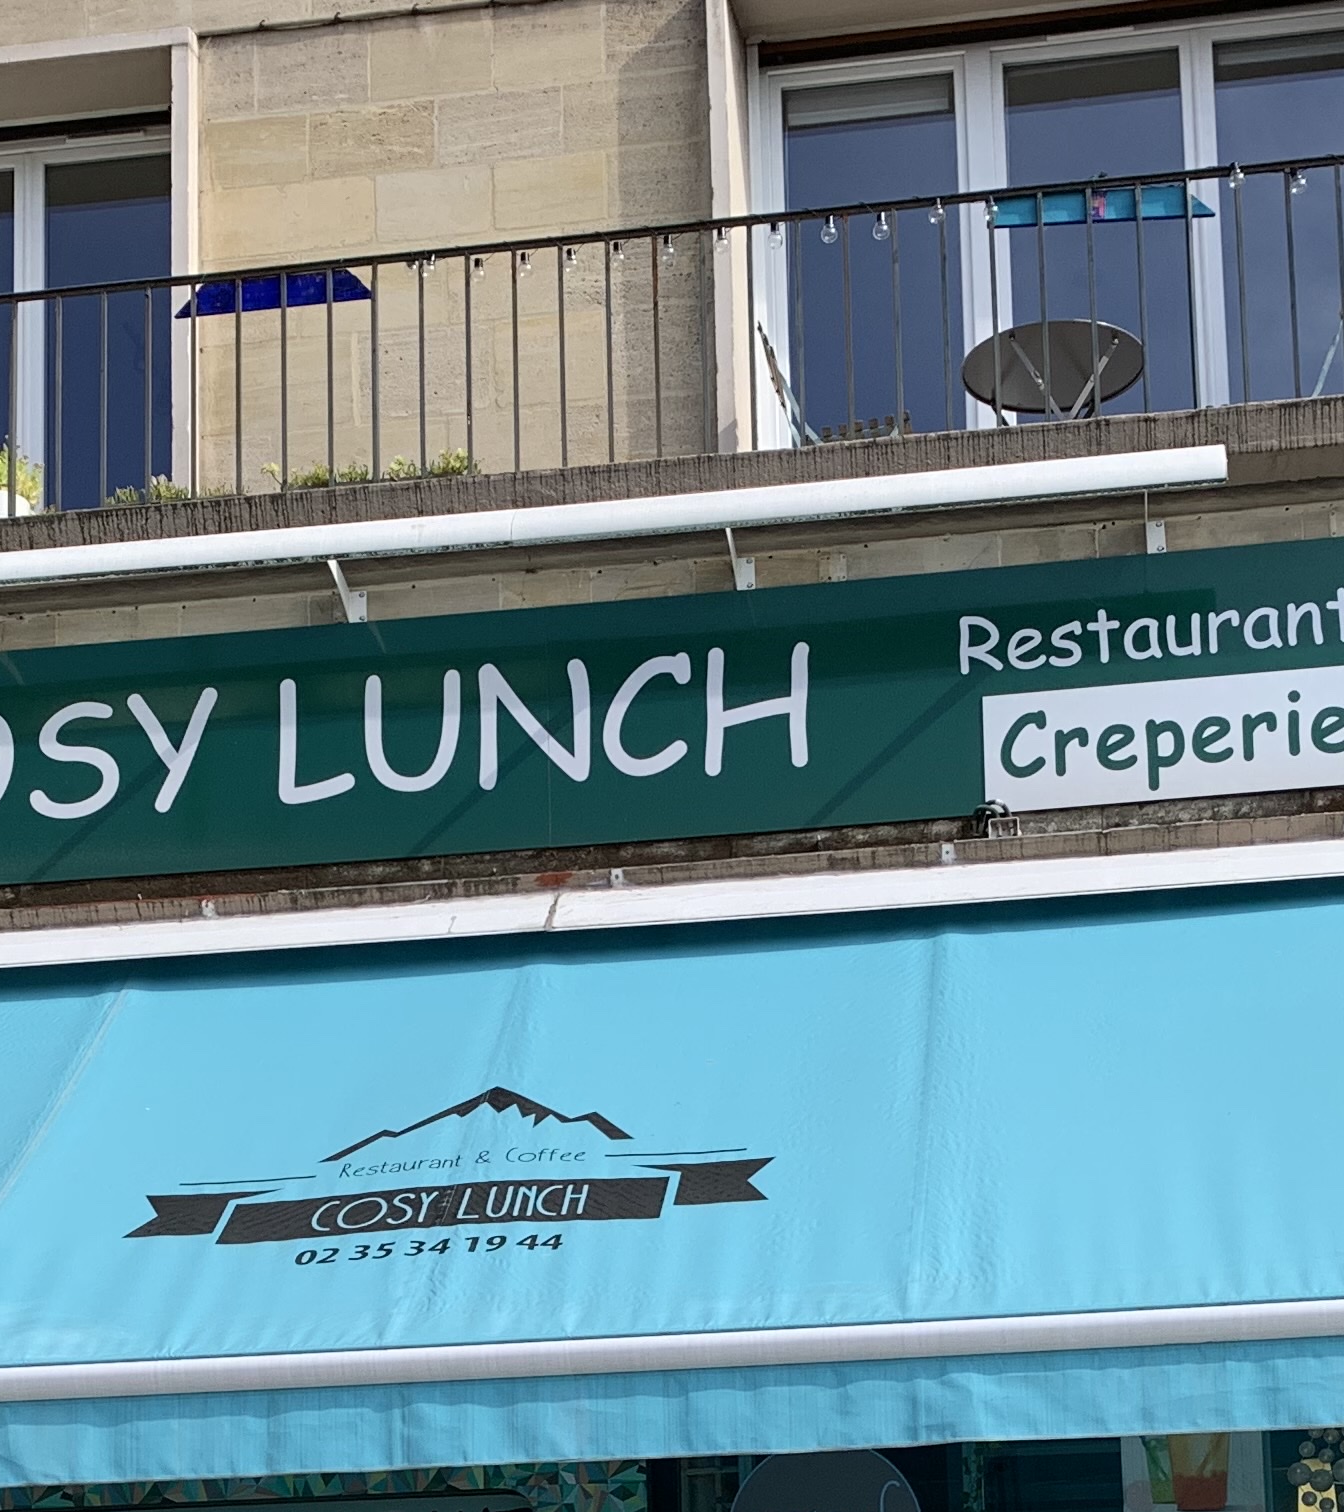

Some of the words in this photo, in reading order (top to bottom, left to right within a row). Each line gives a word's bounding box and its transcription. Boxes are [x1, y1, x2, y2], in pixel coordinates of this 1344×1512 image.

[276, 641, 811, 805] LUNCH
[339, 1153, 462, 1180] Restaurant
[476, 1150, 491, 1164] &
[505, 1146, 587, 1164] Coffee
[310, 1190, 440, 1233] COSY
[457, 1184, 590, 1220] LUNCH
[294, 1246, 337, 1266] 02
[348, 1241, 393, 1262] 35
[404, 1238, 451, 1257] 34
[464, 1234, 508, 1254] 19
[515, 1233, 564, 1252] 44
